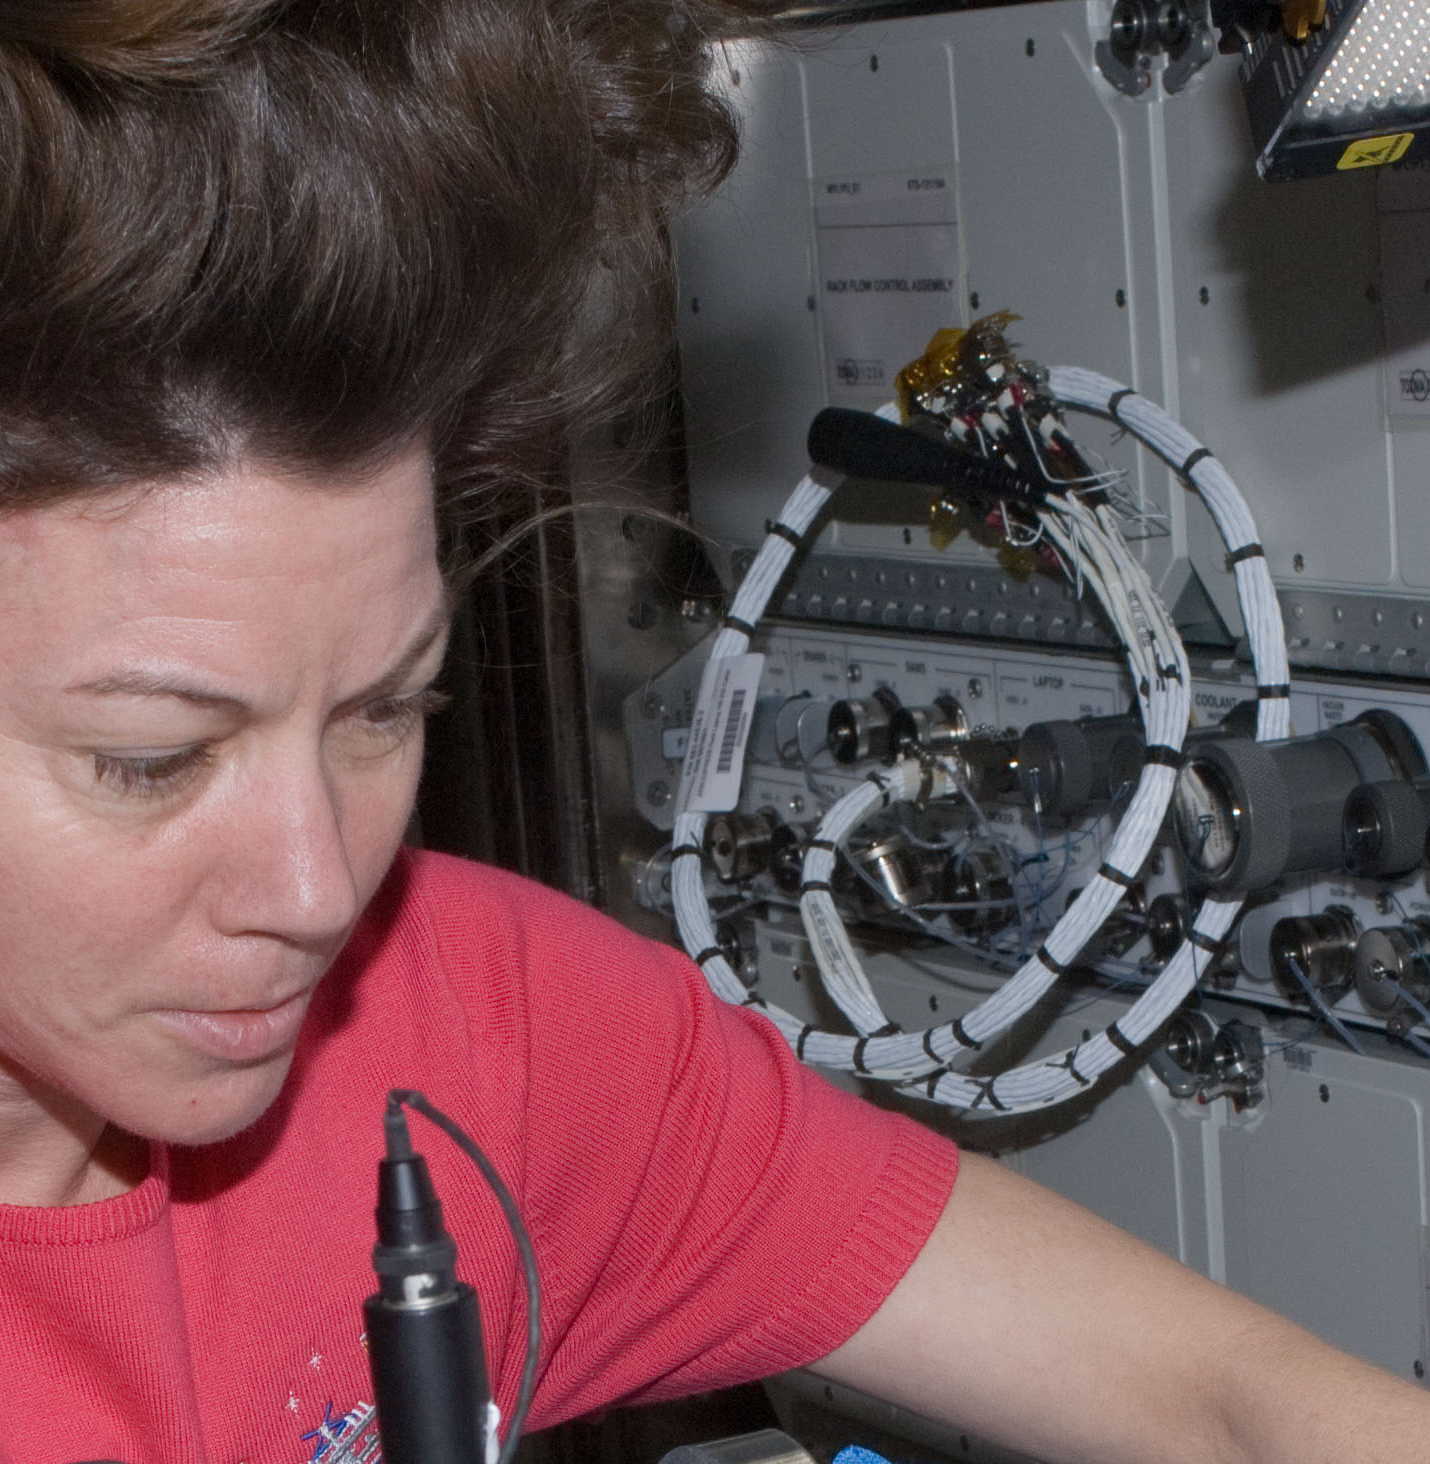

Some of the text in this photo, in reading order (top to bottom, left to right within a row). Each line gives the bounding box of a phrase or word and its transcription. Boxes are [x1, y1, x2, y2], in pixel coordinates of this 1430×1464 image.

[850, 279, 872, 293] FLOW
[874, 278, 909, 292] CONTROL
[912, 278, 954, 292] ASSEMBLY
[1021, 674, 1066, 692] LAPTOP
[1195, 692, 1238, 708] COOLANT
